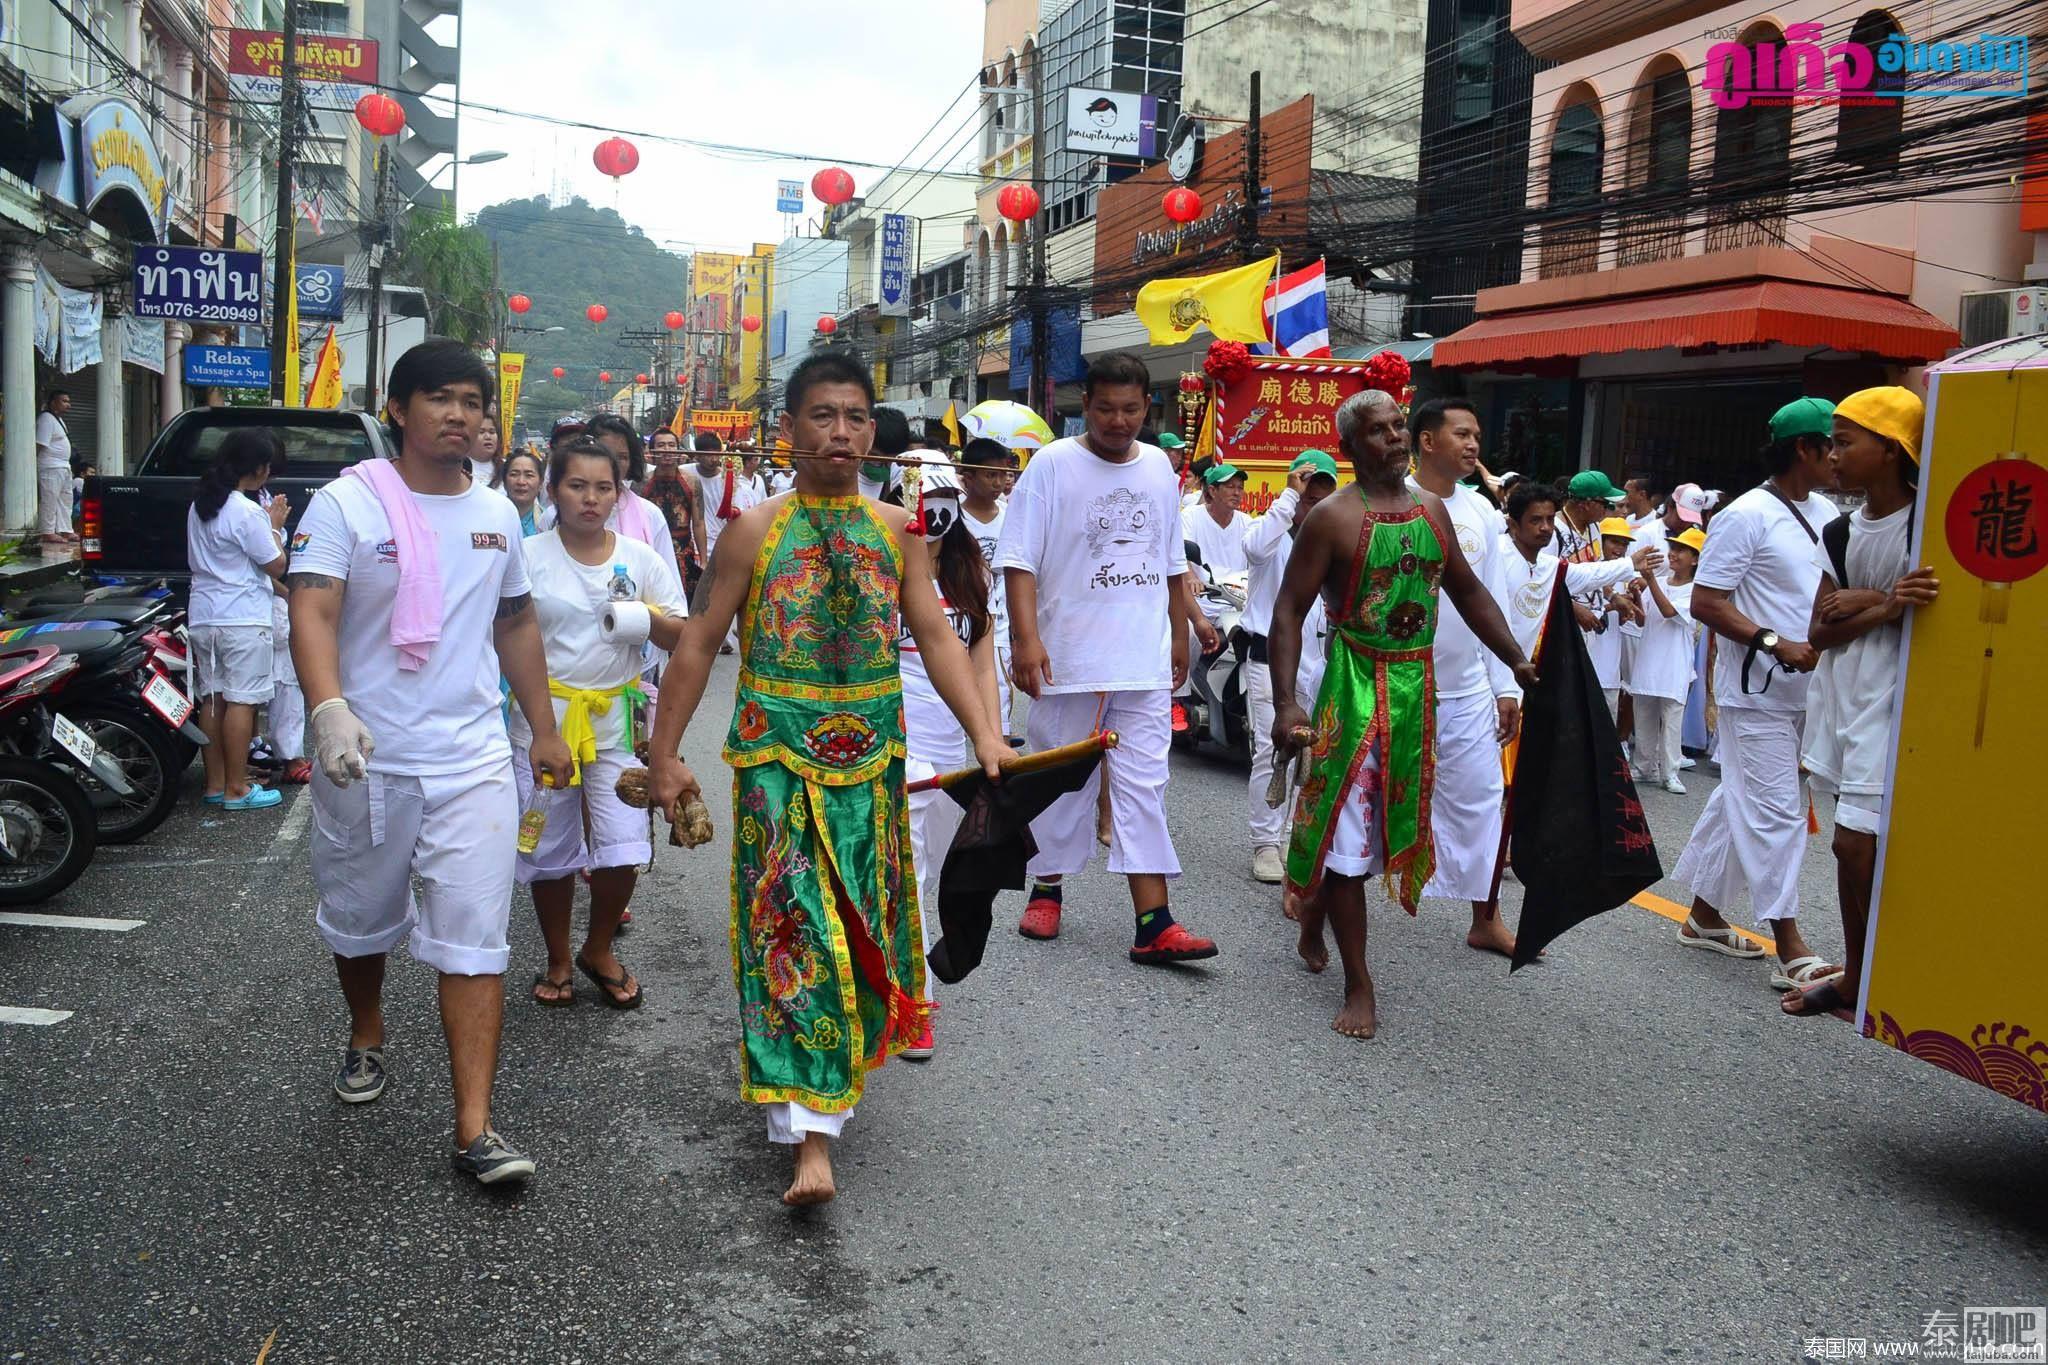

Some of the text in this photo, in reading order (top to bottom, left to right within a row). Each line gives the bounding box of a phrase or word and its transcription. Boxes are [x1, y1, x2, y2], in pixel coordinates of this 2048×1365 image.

[779, 188, 803, 199] TMB
[137, 249, 260, 303] ทำฟัน
[138, 298, 258, 322] โทร.076-220949
[205, 350, 252, 366] Relax
[192, 365, 235, 379] Massage
[245, 367, 265, 379] Spa
[1970, 478, 2039, 560] 龍
[1090, 562, 1160, 589] เจี๊ยะฉ่าย
[170, 700, 188, 722] 5006
